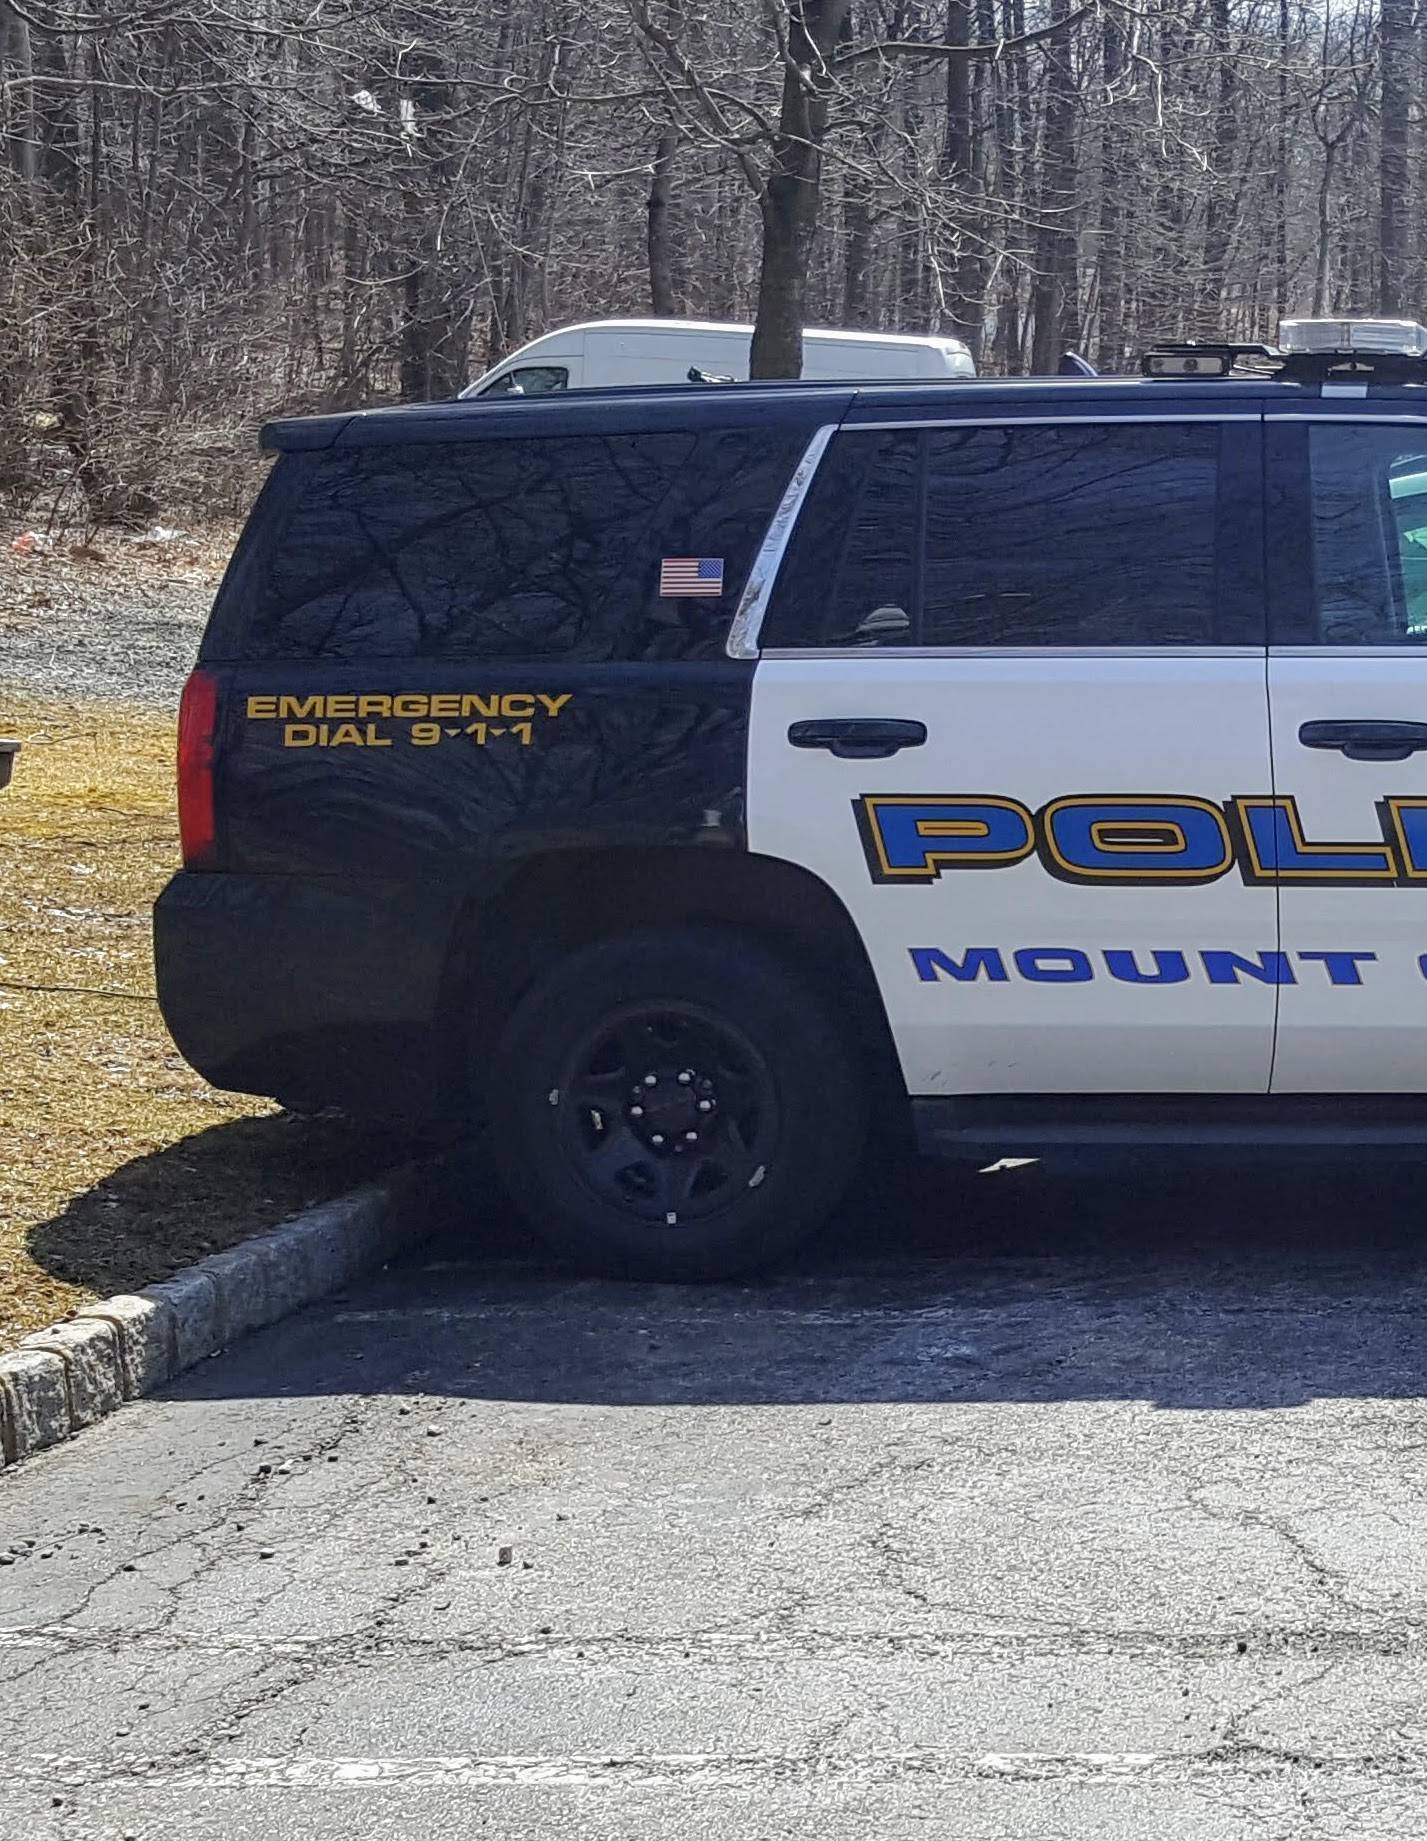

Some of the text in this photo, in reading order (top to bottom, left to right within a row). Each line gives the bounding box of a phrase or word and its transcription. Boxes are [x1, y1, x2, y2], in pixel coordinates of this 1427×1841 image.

[246, 693, 573, 719] EMERGENCY
[284, 723, 392, 747] DIAL
[907, 946, 1377, 986] MOUNT
